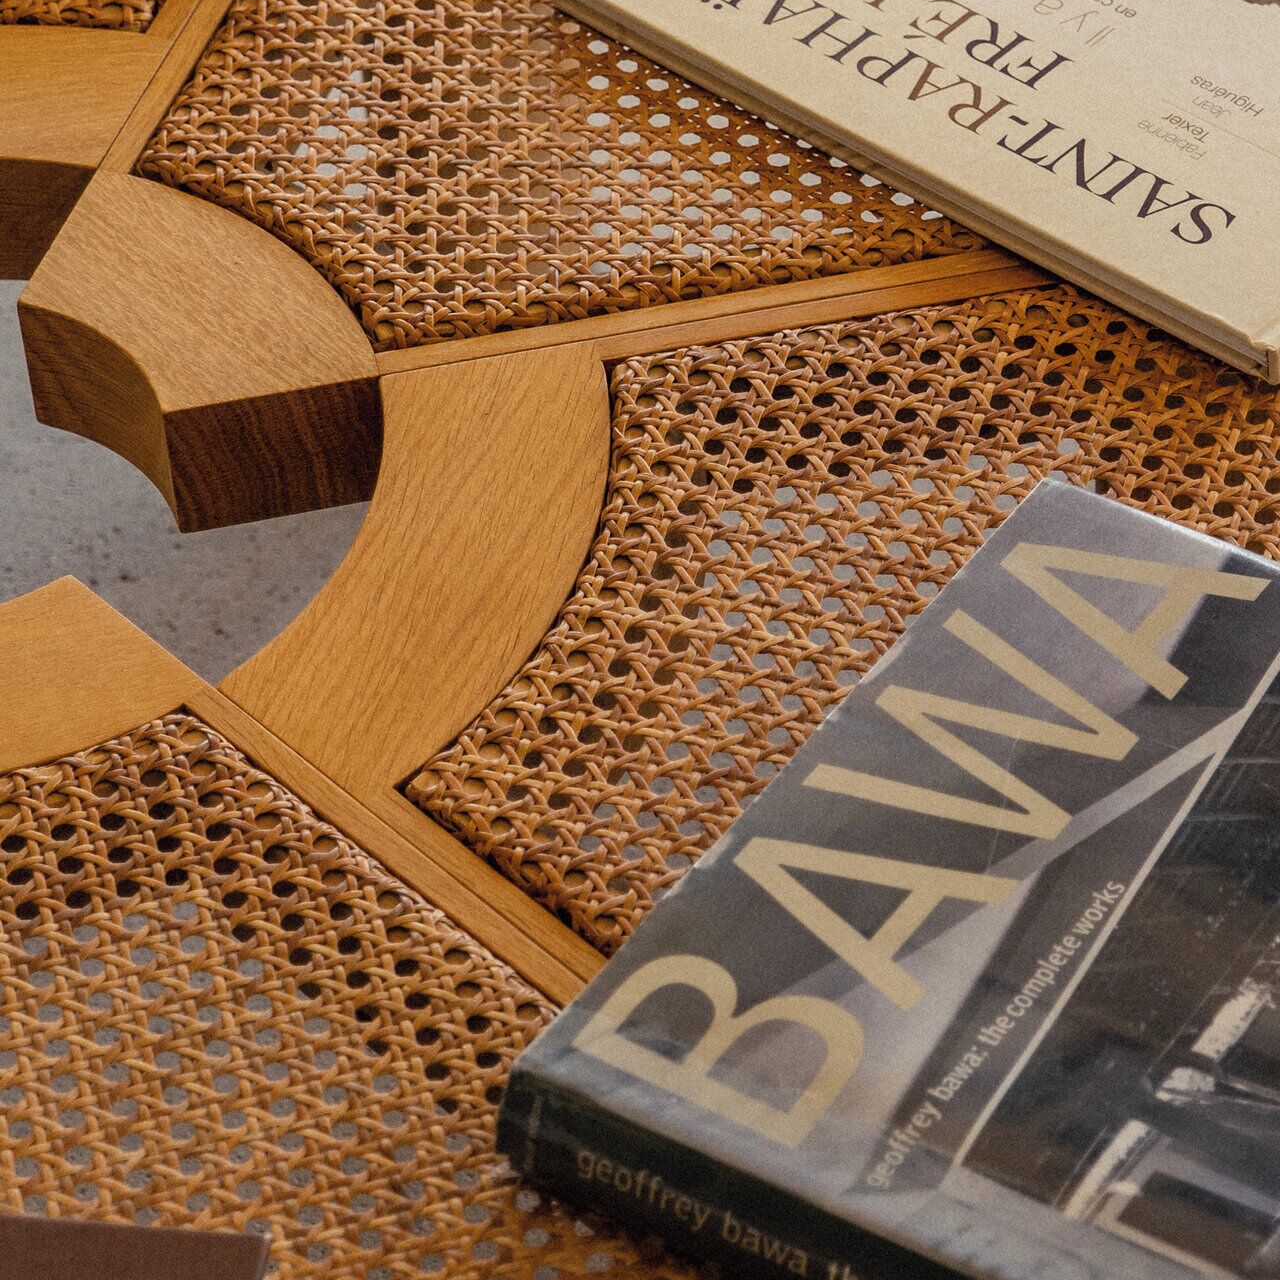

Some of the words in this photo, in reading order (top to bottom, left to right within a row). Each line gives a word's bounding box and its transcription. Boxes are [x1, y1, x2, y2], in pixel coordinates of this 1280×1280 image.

[1064, 8, 1090, 34] y
[1114, 3, 1139, 20] en
[1089, 26, 1117, 48] Il
[1189, 73, 1266, 118] Higuéras
[1192, 94, 1232, 119] Jean
[1137, 119, 1208, 161] Fabienne
[1161, 113, 1211, 145] Texier
[571, 542, 1272, 1150] BAWA
[866, 1099, 943, 1188] geoffrey
[927, 1046, 988, 1101] bawa:
[978, 1015, 1016, 1048] the
[1006, 933, 1082, 1018] complete
[1073, 880, 1126, 937] works
[577, 1148, 714, 1233] geoffrey
[721, 1210, 809, 1277] bawa
